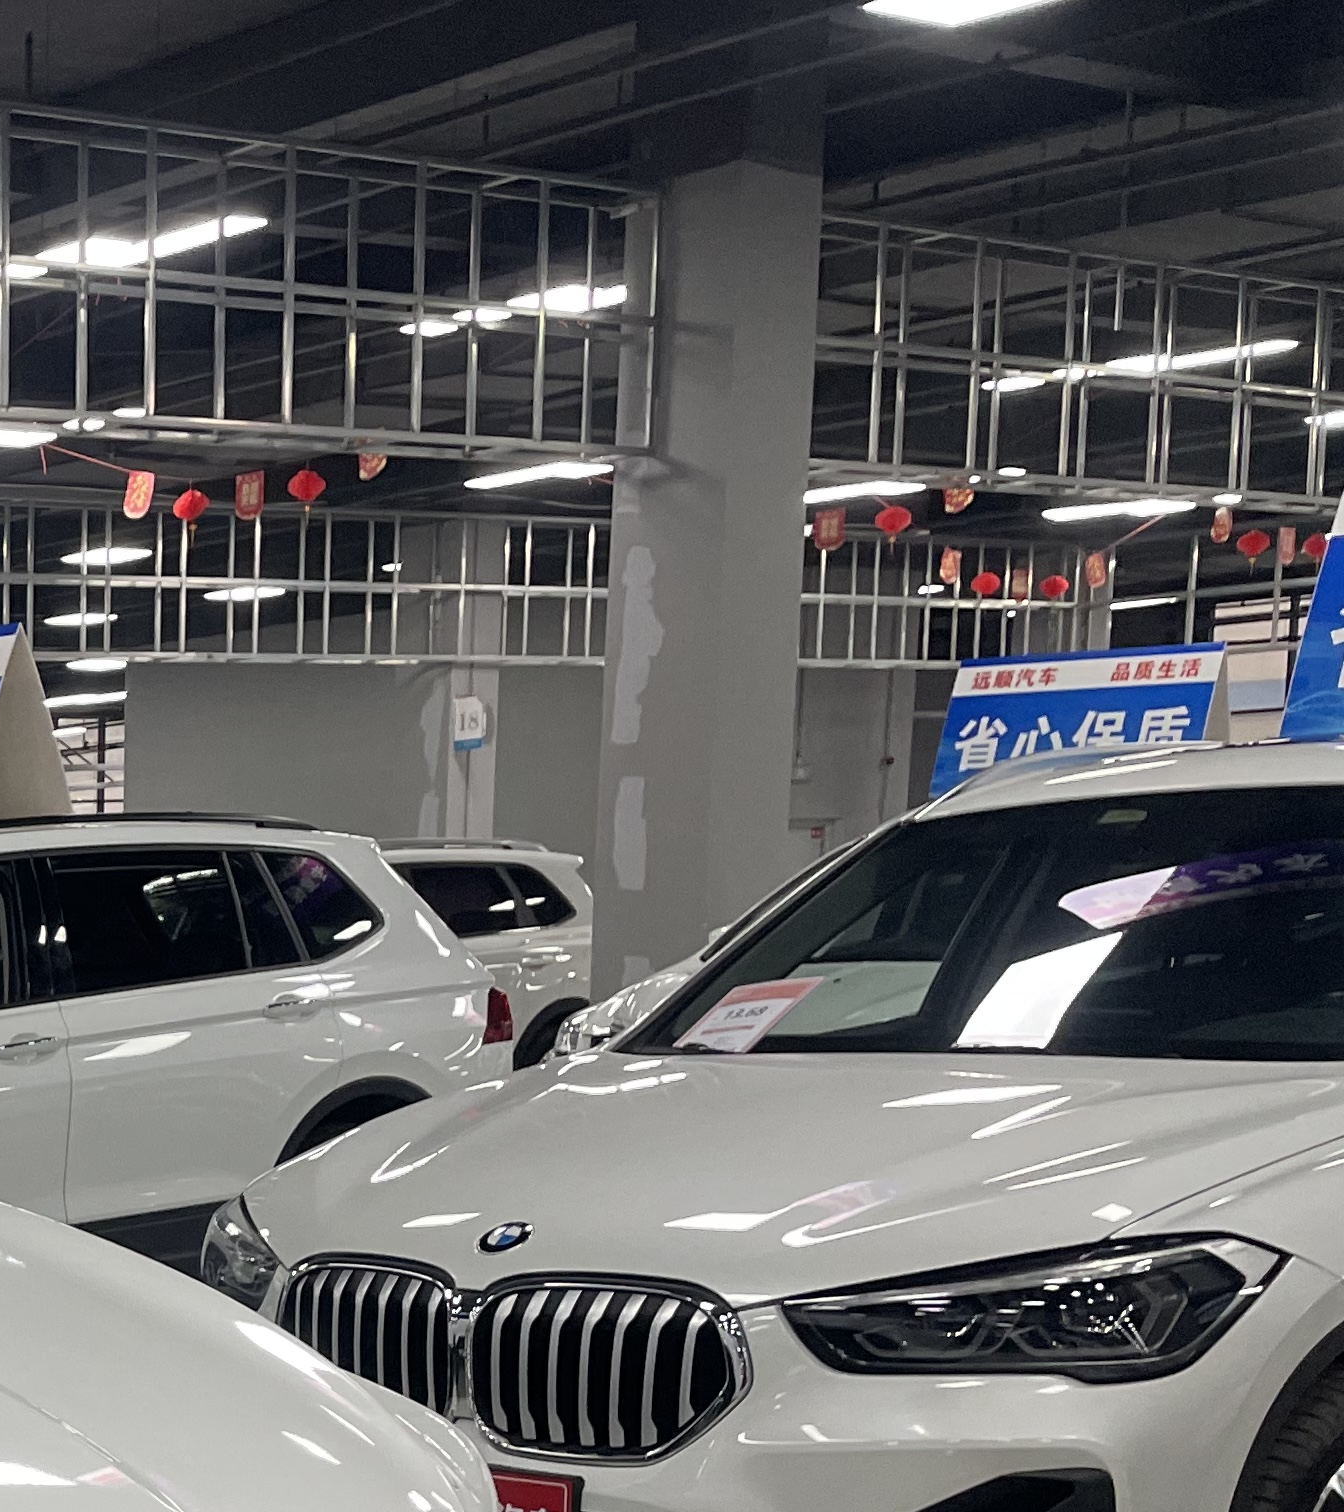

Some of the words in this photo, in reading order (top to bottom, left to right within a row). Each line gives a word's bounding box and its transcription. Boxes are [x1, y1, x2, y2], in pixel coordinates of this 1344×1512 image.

[972, 667, 1059, 690] 远顺汽车
[1110, 658, 1202, 682] 品质生活
